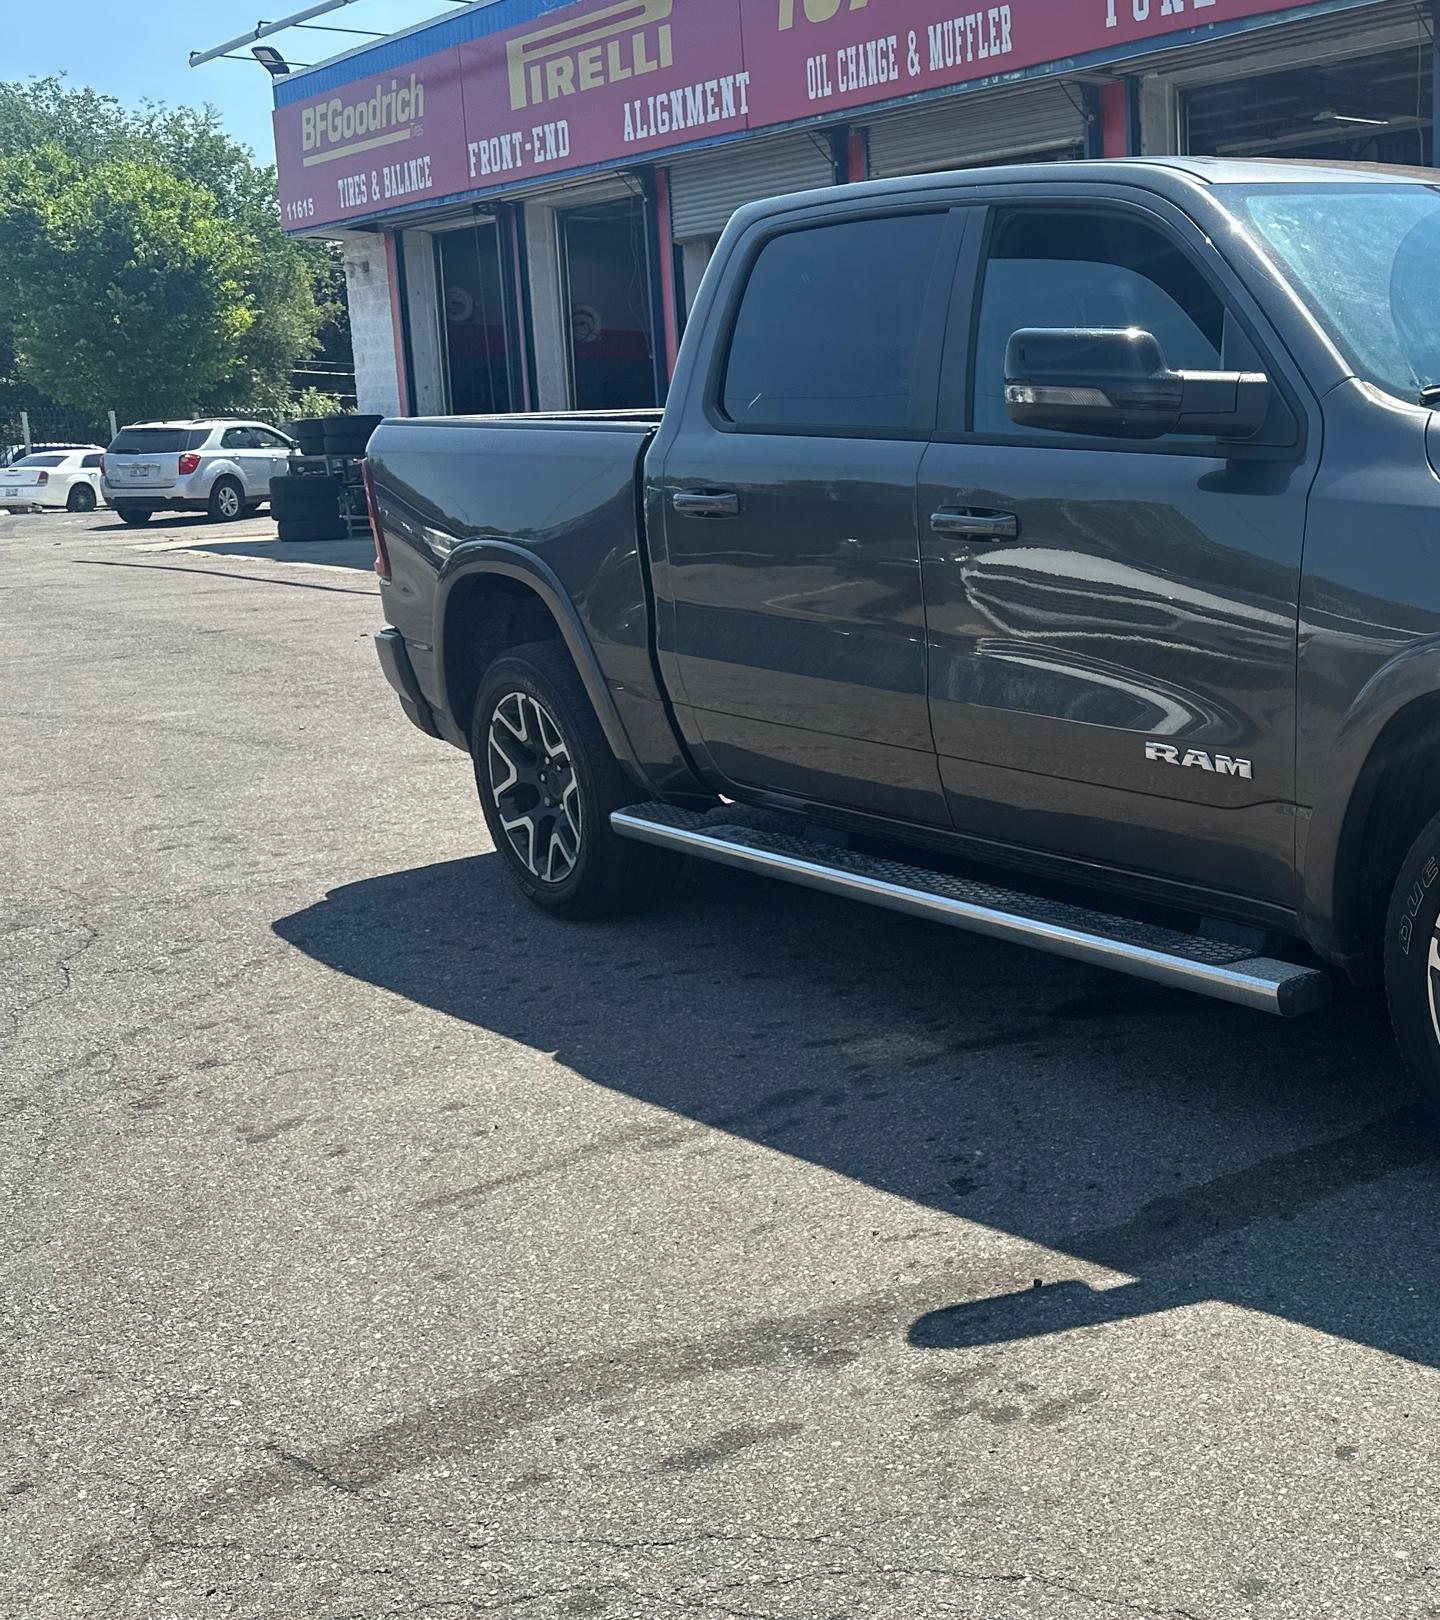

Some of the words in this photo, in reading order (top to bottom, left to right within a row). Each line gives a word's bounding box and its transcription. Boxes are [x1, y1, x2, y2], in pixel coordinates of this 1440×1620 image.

[506, 0, 673, 111] PIRELLI
[806, 54, 832, 100] OIL
[837, 35, 899, 93] CHANGE
[907, 30, 921, 77] &
[928, 5, 1013, 71] MUFFLER
[302, 73, 424, 151] BFGoodrich
[468, 119, 570, 178] FRONT-END
[623, 71, 750, 142] ALIGNMENT
[287, 197, 314, 221] 11615
[337, 173, 367, 208] TIRES
[371, 170, 380, 201] &
[383, 155, 433, 199] BALANCE
[1145, 741, 1252, 779] RAM
